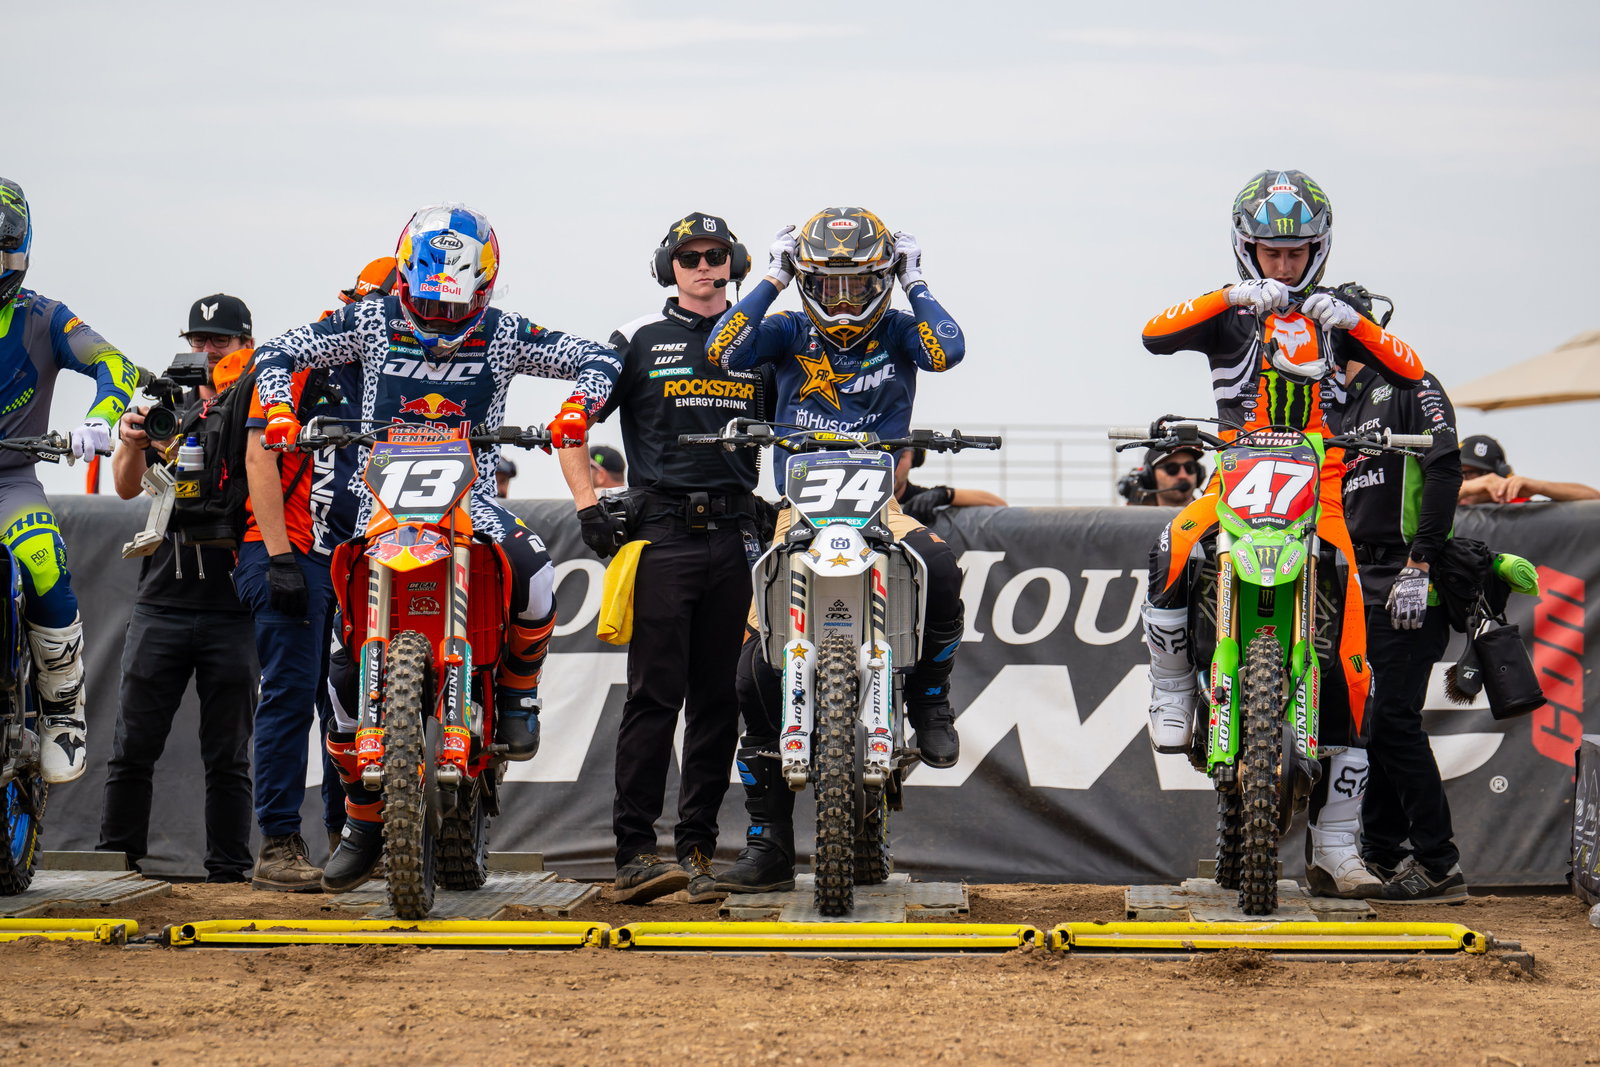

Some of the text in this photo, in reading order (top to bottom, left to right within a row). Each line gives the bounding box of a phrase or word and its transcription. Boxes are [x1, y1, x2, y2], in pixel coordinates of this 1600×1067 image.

[434, 236, 460, 248] Arai
[420, 284, 462, 296] Red Bull
[734, 324, 754, 346] DRINK
[1380, 329, 1416, 367] FOX
[659, 367, 692, 376] MOTOREX
[663, 379, 755, 400] ROCKSTAR
[675, 397, 748, 410] ENERGY DRINK
[378, 459, 465, 509] 13
[796, 469, 887, 513] 34
[1227, 460, 1315, 516] 47
[1252, 516, 1286, 525] Kawasaki
[30, 547, 50, 564] RD1
[1221, 561, 1232, 637] PRO CIRCUIT
[1463, 670, 1475, 679] 47
[872, 669, 881, 716] DUNLO
